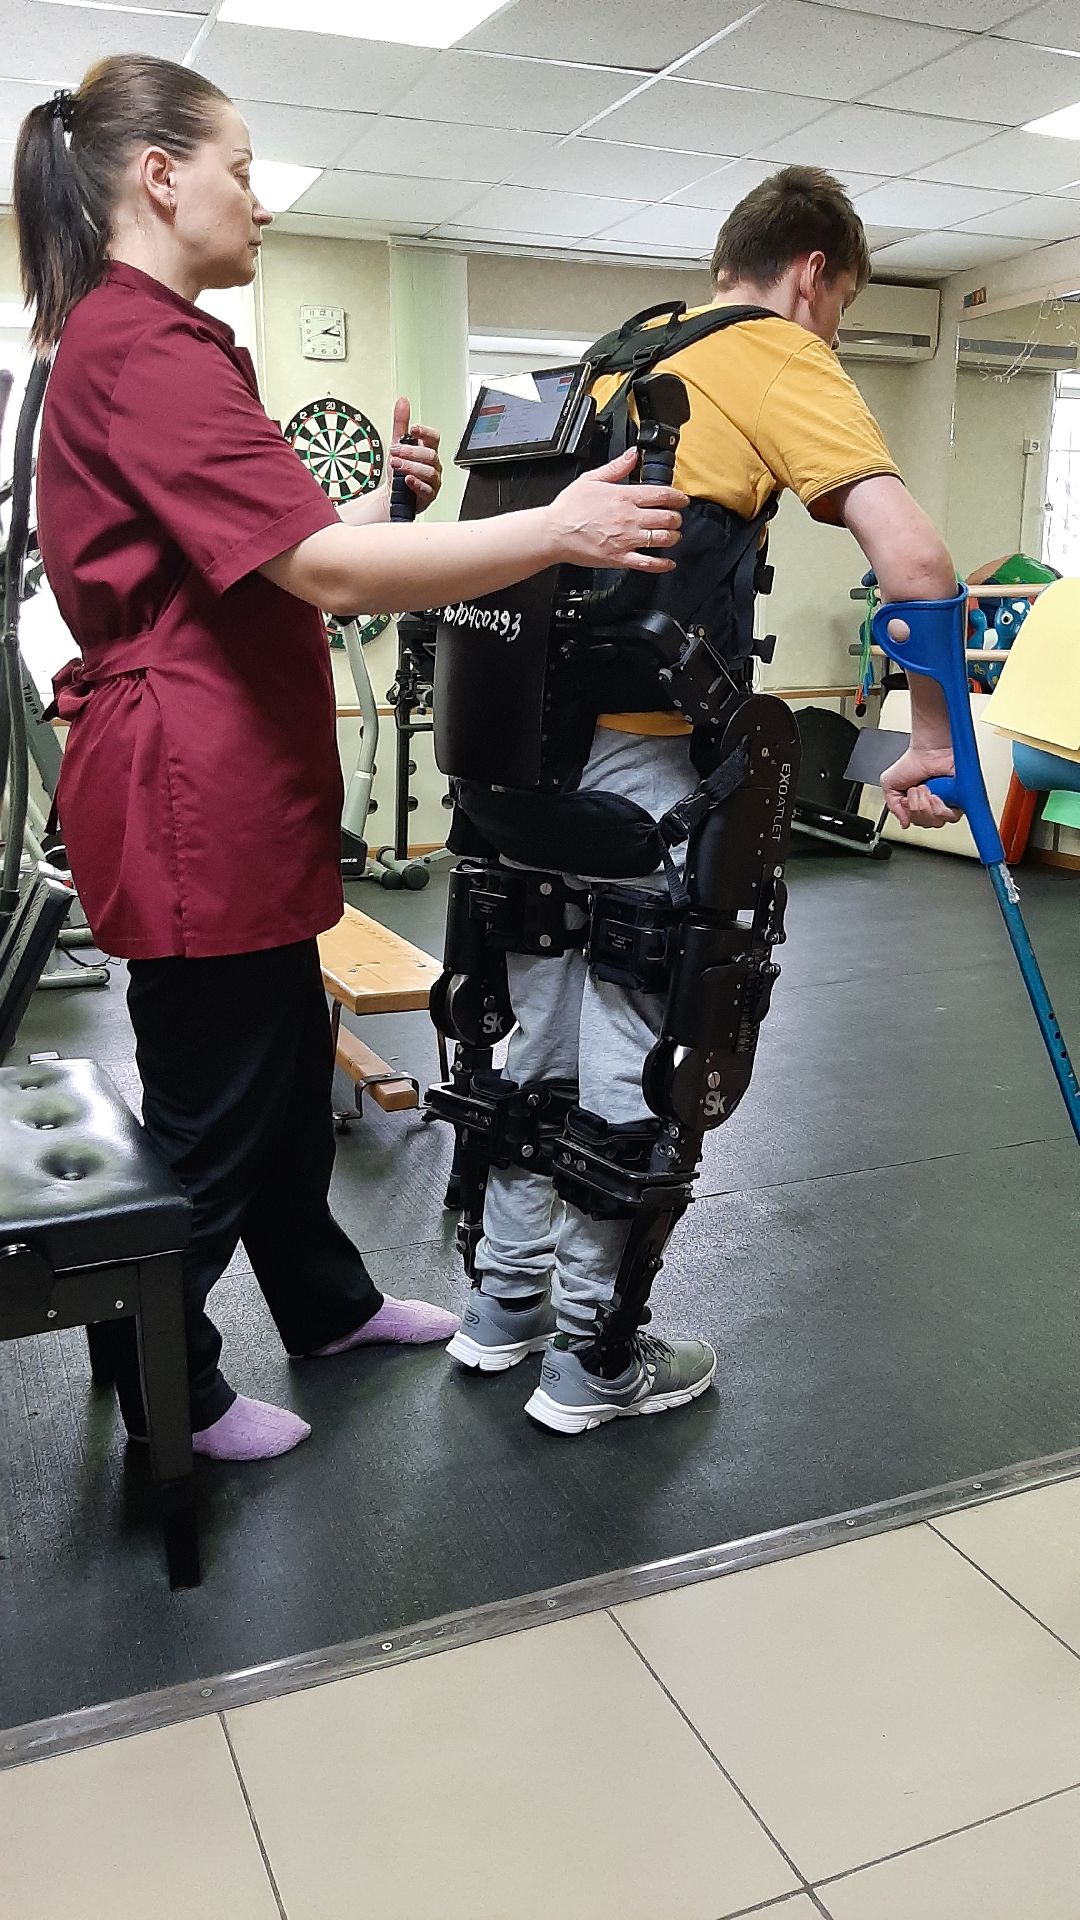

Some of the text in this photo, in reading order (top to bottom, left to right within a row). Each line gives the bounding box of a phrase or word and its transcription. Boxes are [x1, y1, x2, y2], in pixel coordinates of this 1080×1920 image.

[313, 404, 319, 412] 5
[325, 401, 336, 410] 20
[372, 468, 380, 477] 10
[367, 480, 376, 489] 15
[23, 683, 39, 715] Tigra
[771, 763, 792, 843] EXOATLET
